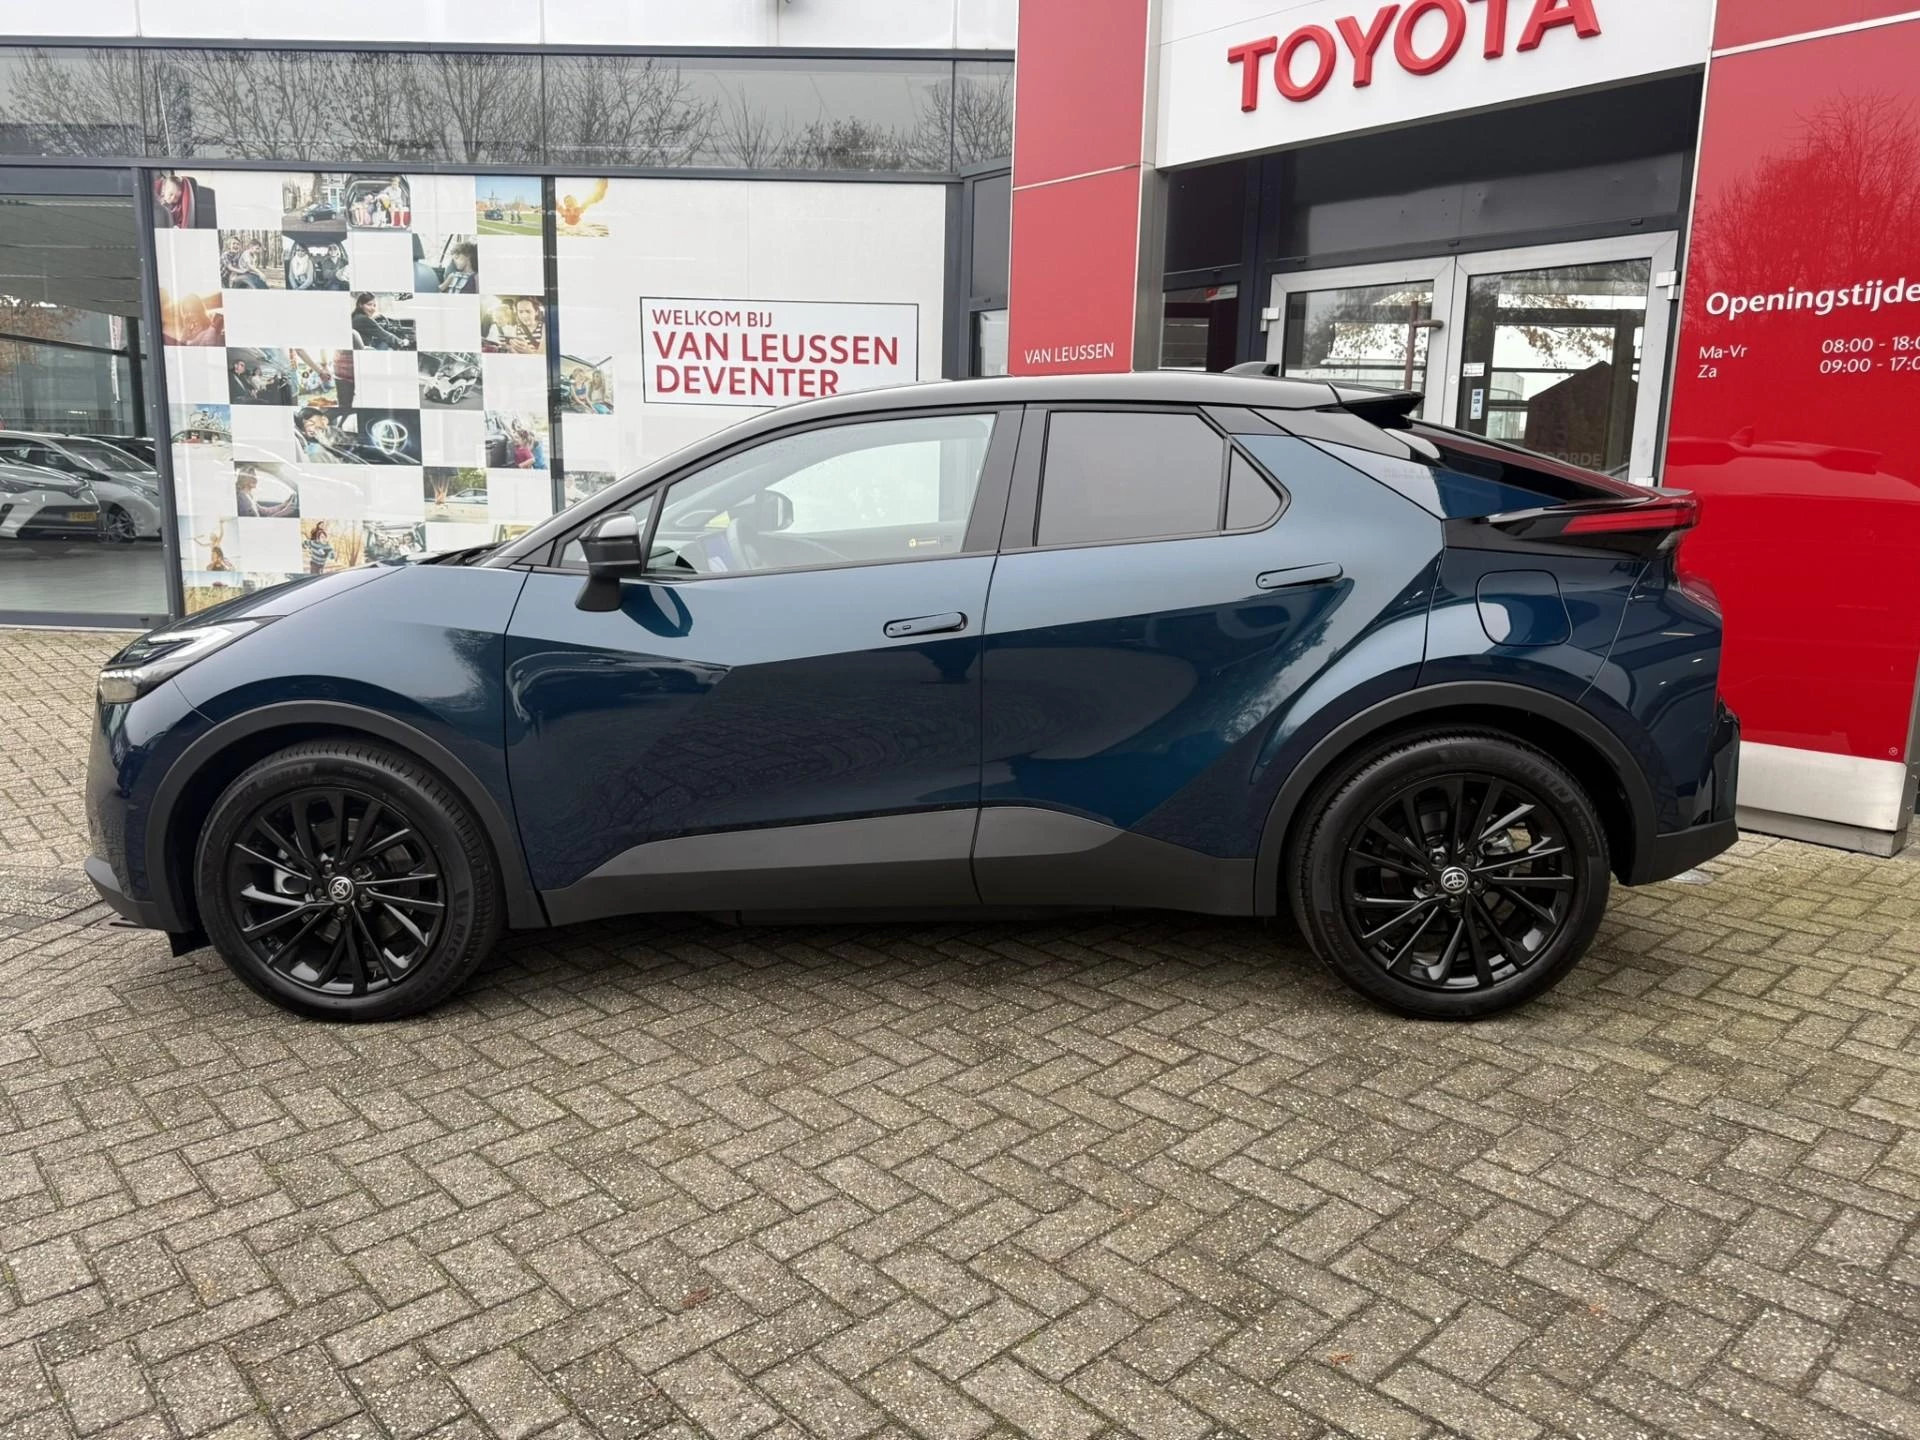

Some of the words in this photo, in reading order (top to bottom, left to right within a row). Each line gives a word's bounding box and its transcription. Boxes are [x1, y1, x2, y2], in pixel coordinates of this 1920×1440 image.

[1227, 0, 1602, 113] TOYOTA
[1706, 277, 1920, 321] Openingstijde
[652, 309, 741, 327] WELKOM
[747, 311, 773, 328] BIJ
[652, 331, 729, 361] VAN
[741, 333, 899, 366] LEUSSEN
[1024, 347, 1051, 365] VAN
[1054, 342, 1115, 362] LEUSSEN
[1699, 344, 1748, 359] Ma-Vr
[1821, 337, 1874, 354] 08:00
[656, 364, 840, 398] DEVENTER
[1697, 364, 1717, 378] Za
[1820, 358, 1871, 374] 09:00
